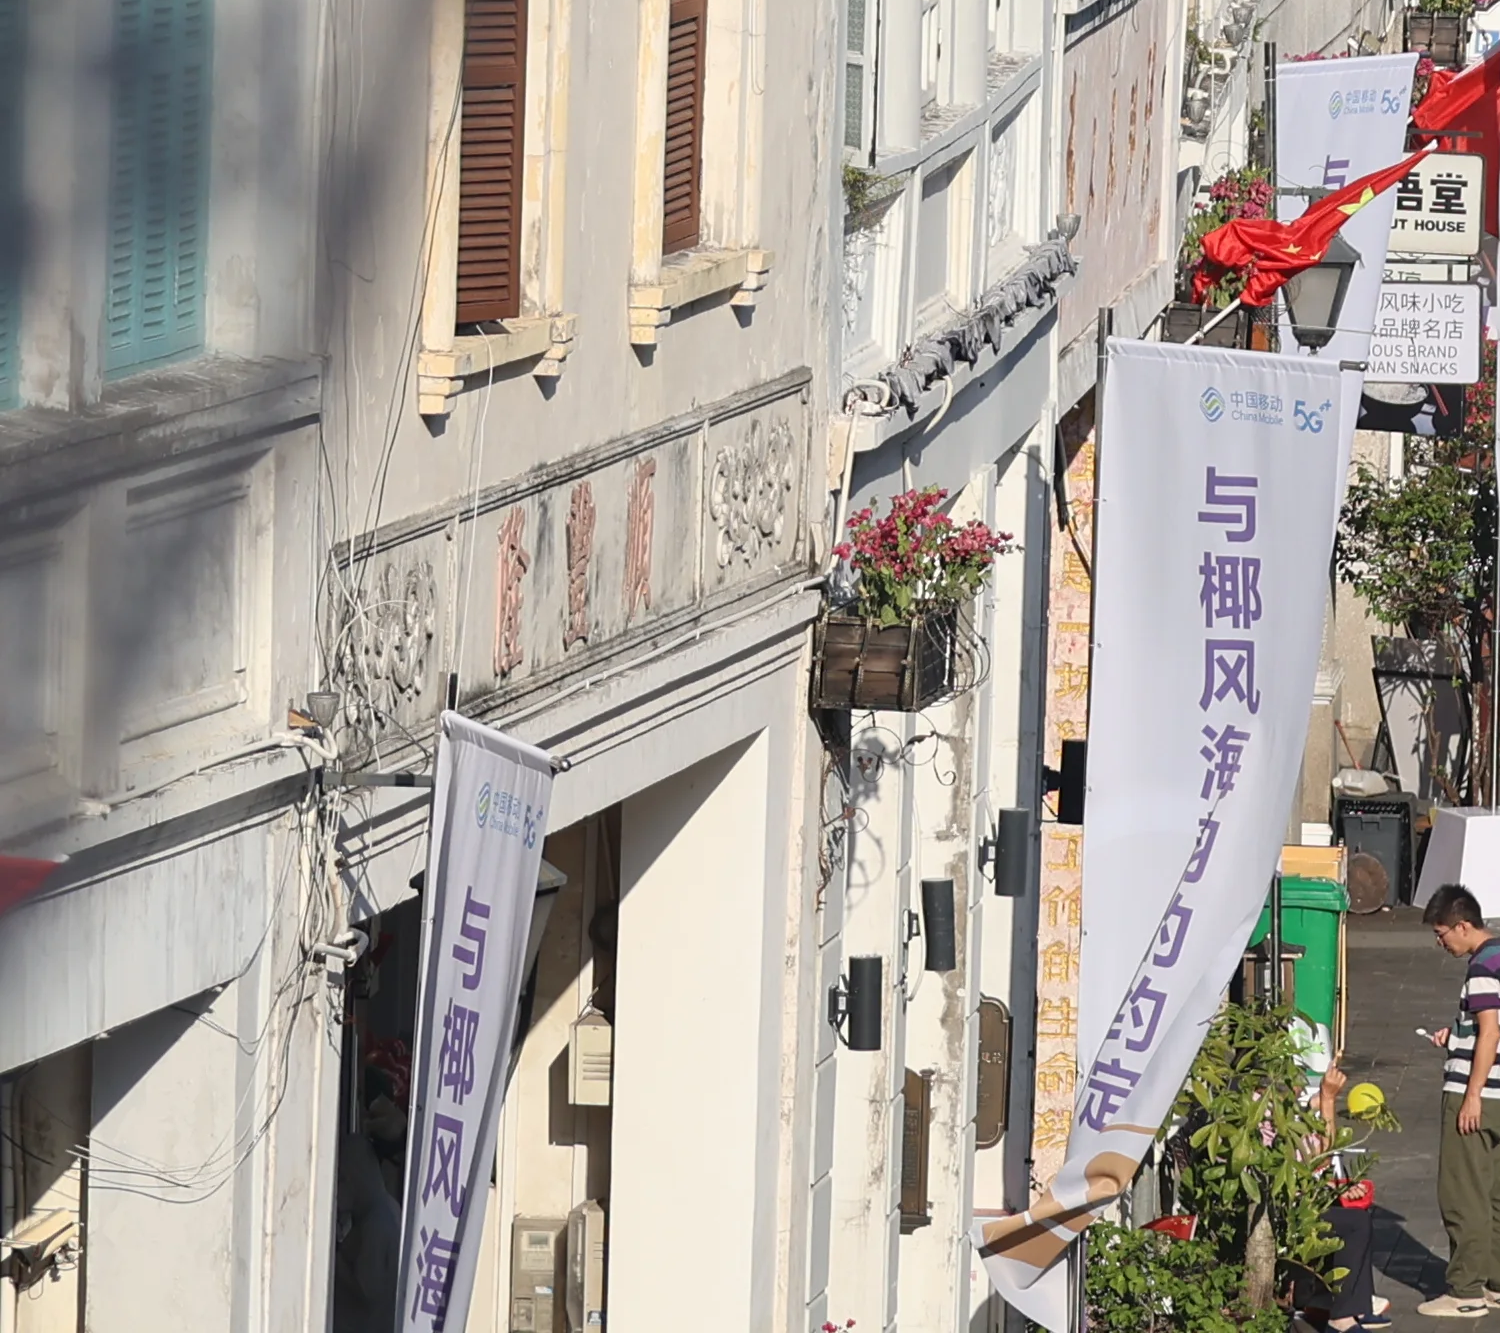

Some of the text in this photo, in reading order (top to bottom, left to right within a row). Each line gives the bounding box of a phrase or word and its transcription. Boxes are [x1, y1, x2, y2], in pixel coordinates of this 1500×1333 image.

[1414, 219, 1467, 233] HOUSE
[1379, 292, 1466, 315] 风味小吃
[1369, 343, 1458, 359] OUS BRAND
[1400, 361, 1458, 375] SNACKS
[1230, 391, 1283, 413] 中国移动
[1231, 409, 1284, 426] China Mobile
